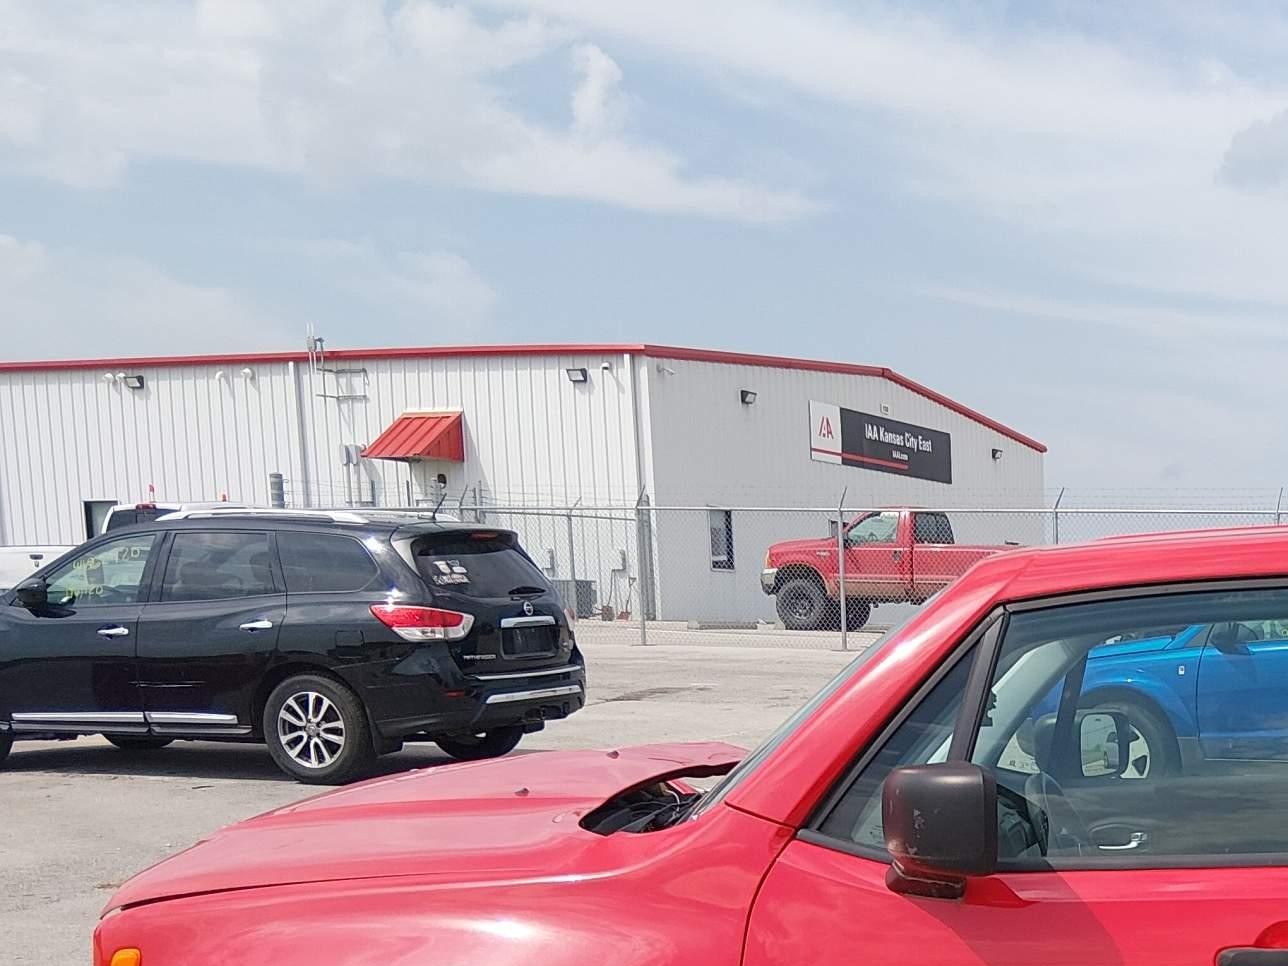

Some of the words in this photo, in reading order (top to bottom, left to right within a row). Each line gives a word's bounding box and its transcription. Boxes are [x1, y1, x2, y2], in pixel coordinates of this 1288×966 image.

[865, 424, 879, 441] IAA
[879, 427, 903, 446] Kansas
[905, 432, 917, 452] City
[918, 436, 931, 452] East
